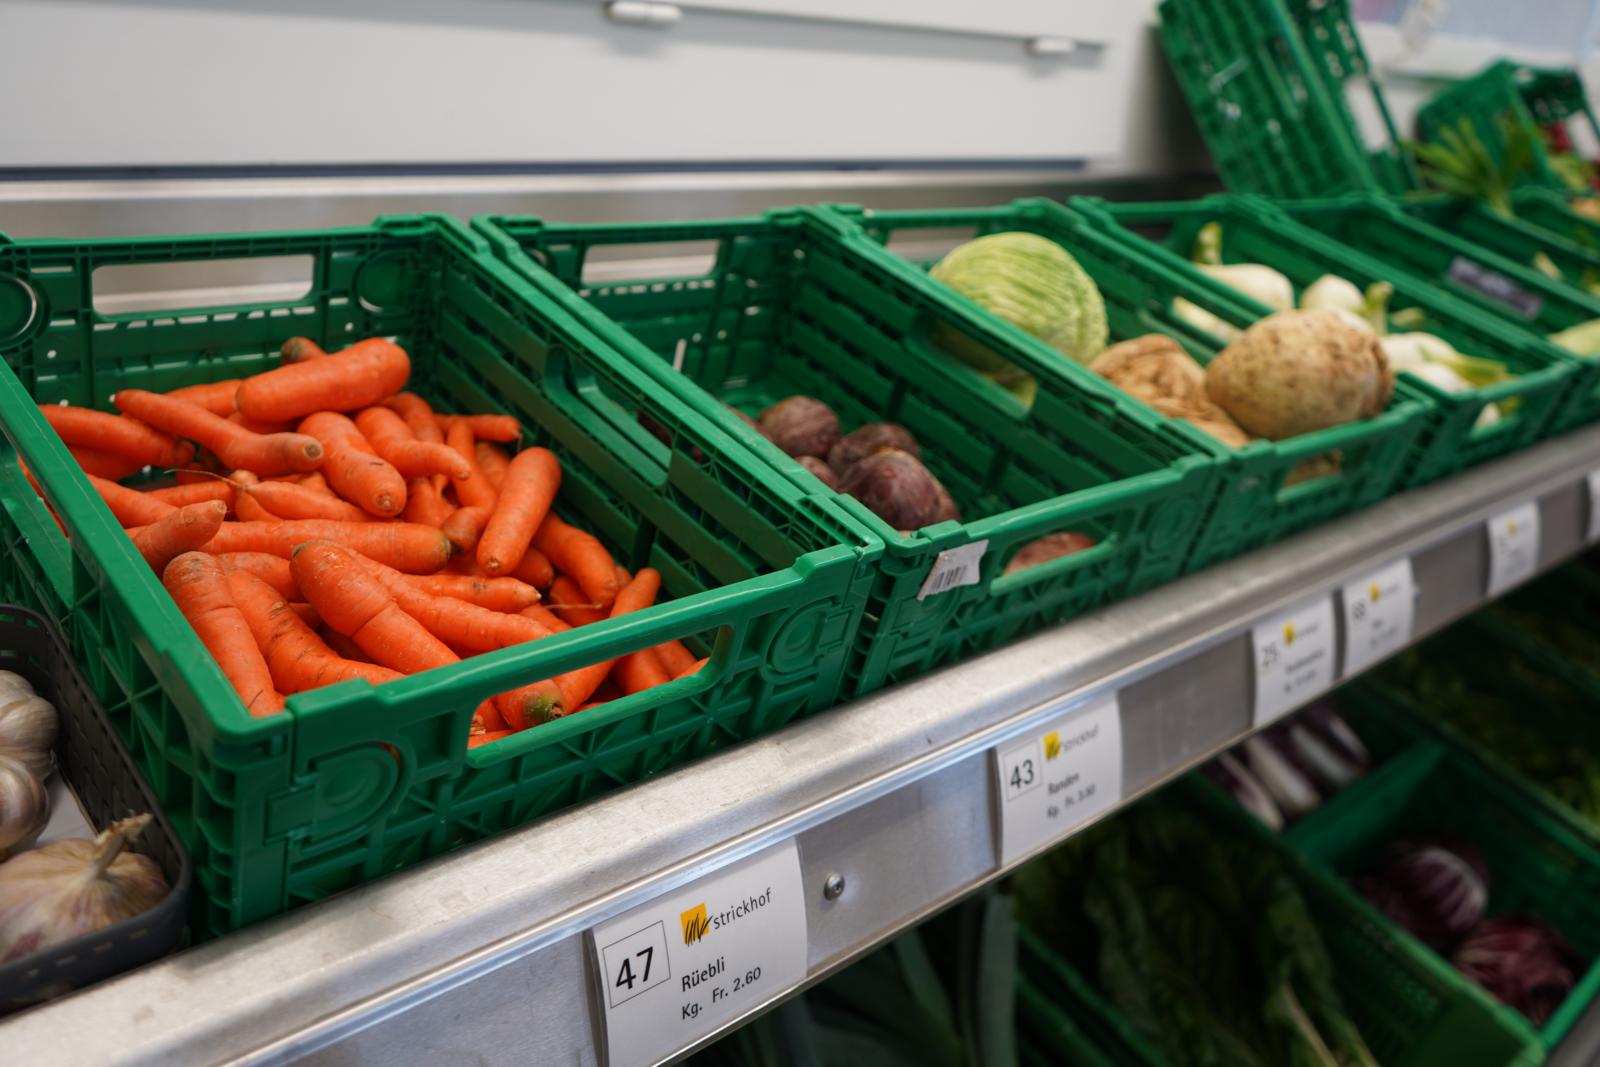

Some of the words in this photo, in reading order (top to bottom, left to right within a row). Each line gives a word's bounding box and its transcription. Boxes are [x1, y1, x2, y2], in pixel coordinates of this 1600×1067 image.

[1009, 758, 1035, 789] 43
[713, 887, 773, 930] strickhof
[615, 946, 654, 990] 47
[682, 956, 726, 992] Rüebli
[681, 1004, 703, 1020] Kg.
[711, 987, 729, 1003] Fr.
[733, 966, 762, 992] 2.60
